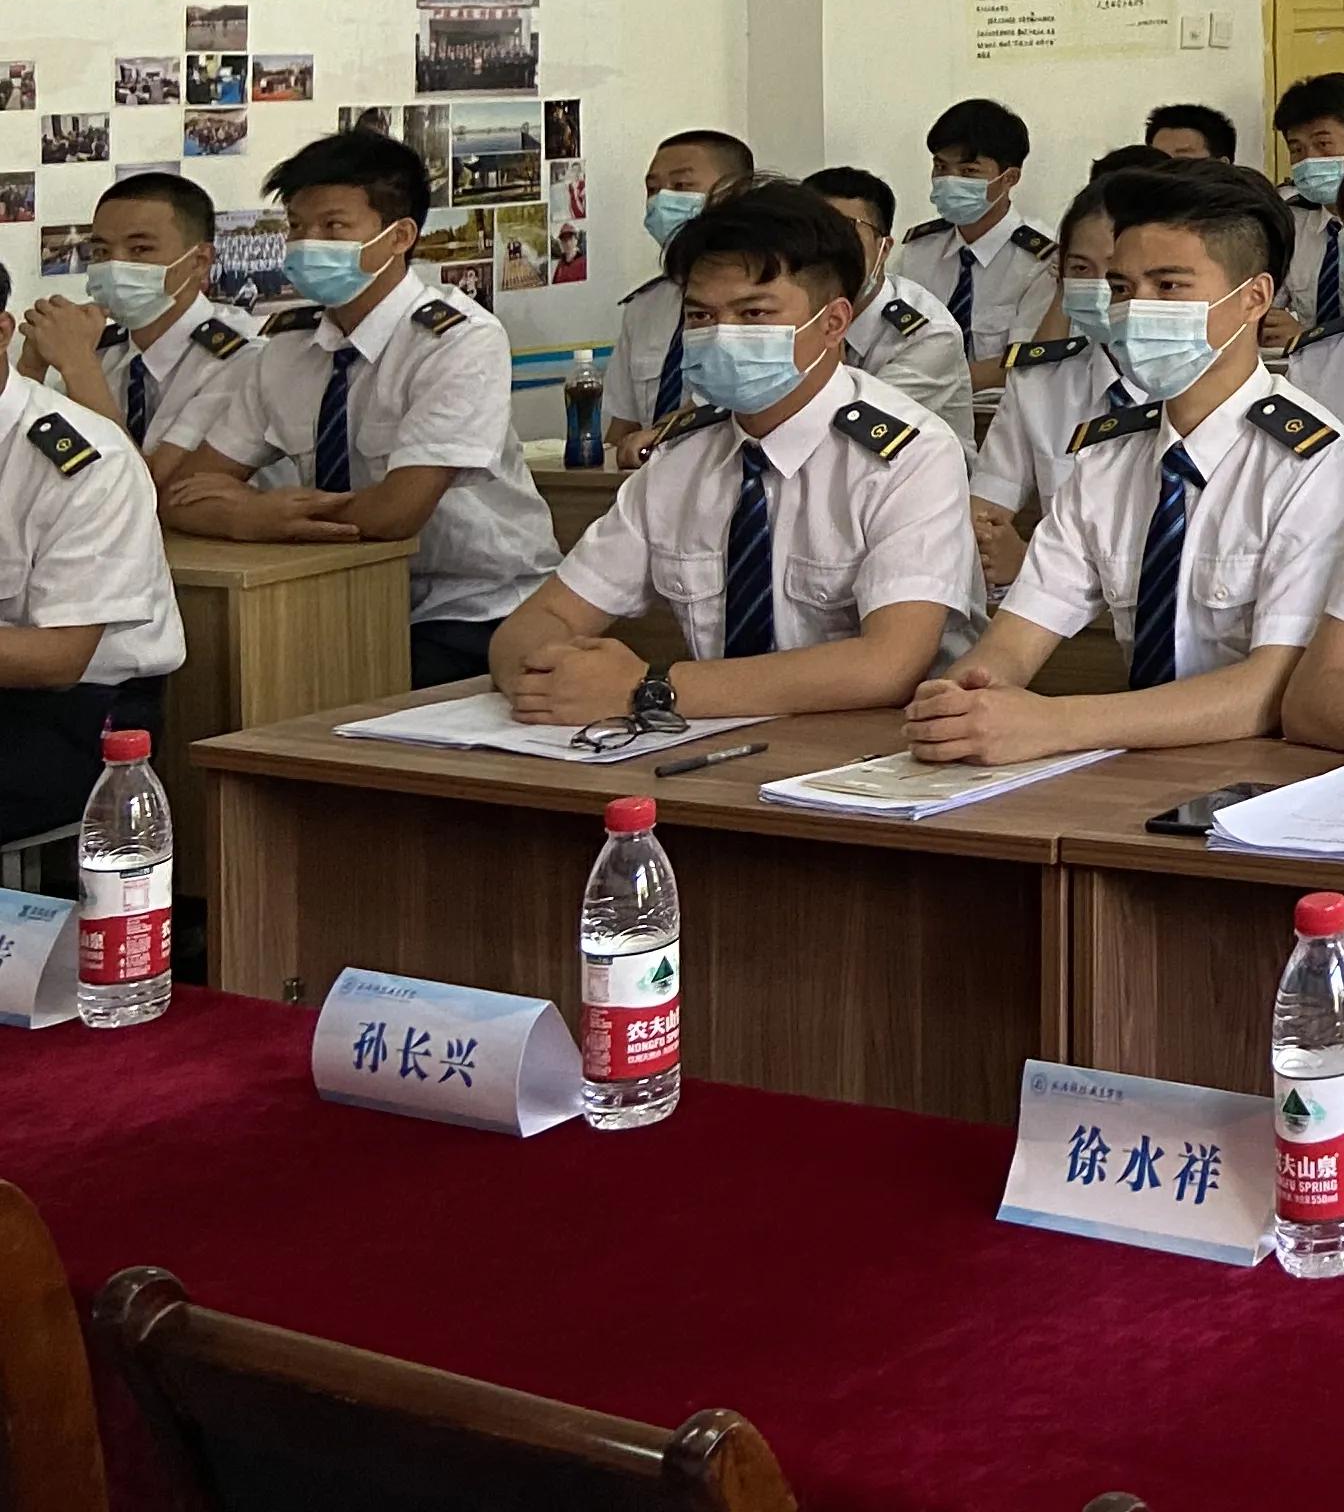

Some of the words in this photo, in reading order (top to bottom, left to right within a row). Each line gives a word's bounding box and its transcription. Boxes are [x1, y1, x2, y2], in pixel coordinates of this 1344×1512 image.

[352, 1021, 479, 1088] 孙长兴
[1066, 1124, 1222, 1205] 徐水祥
[1299, 1179, 1338, 1193] SPRING
